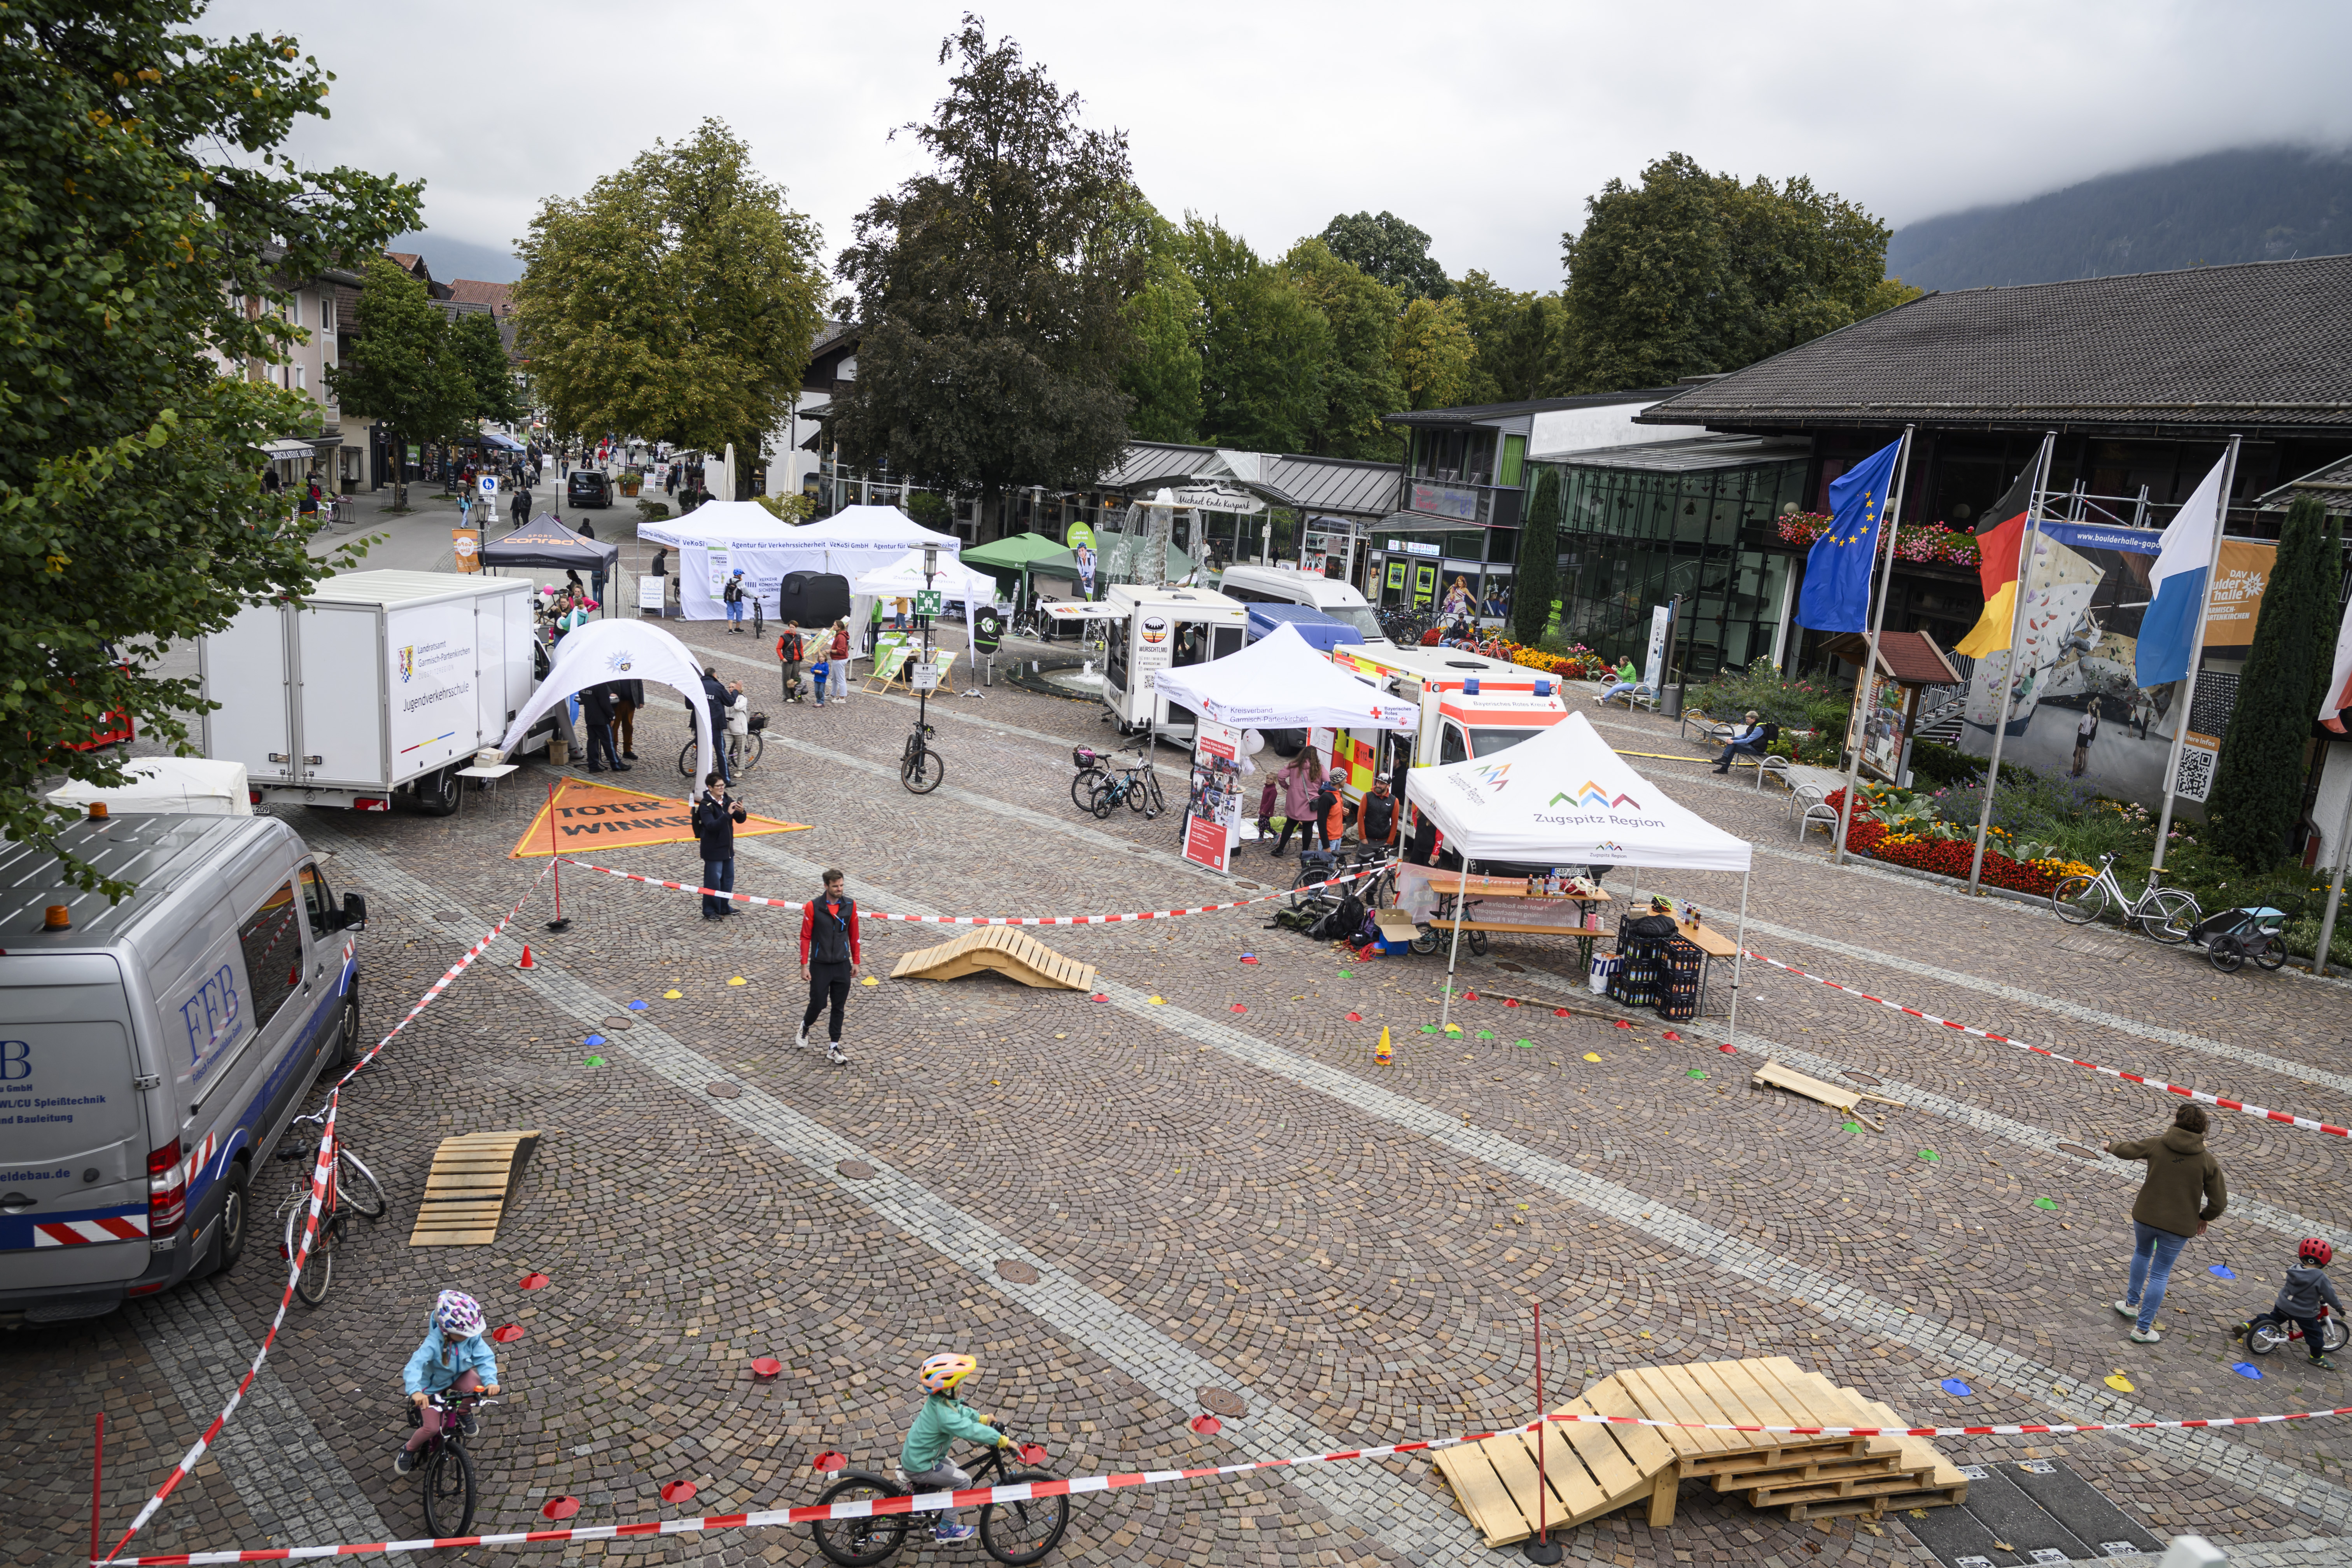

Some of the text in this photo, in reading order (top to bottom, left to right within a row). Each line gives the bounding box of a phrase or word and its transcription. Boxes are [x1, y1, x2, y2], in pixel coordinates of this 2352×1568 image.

[271, 450, 299, 460] CHOCOLATERIE
[1177, 495, 1250, 513] Michael Ende Kurpark
[1416, 497, 1438, 510] Theater
[2230, 569, 2248, 579] DAV
[2213, 578, 2241, 590] ulder
[2214, 589, 2243, 601] halle
[2207, 612, 2250, 621] ARTENKIRCHEN
[418, 640, 446, 654] Landratsamt
[418, 647, 470, 667] Garmisch-Partenkirchen
[418, 664, 454, 679] ZUGSPITZREGION
[403, 681, 469, 713] Jugendverkehrsschule
[2185, 734, 2215, 747] itere Infos
[1448, 773, 1485, 806] Zugspitz Region
[556, 802, 675, 818] TOTER
[561, 816, 692, 836] WINKE
[1534, 814, 1666, 828] Zugspitz Region
[179, 964, 238, 1067] FFB
[192, 1020, 242, 1085] Fritsch Fernmeldebau GmbH
[34, 1095, 106, 1108] Spleißtechnik
[17, 1114, 73, 1124] Bauleitung
